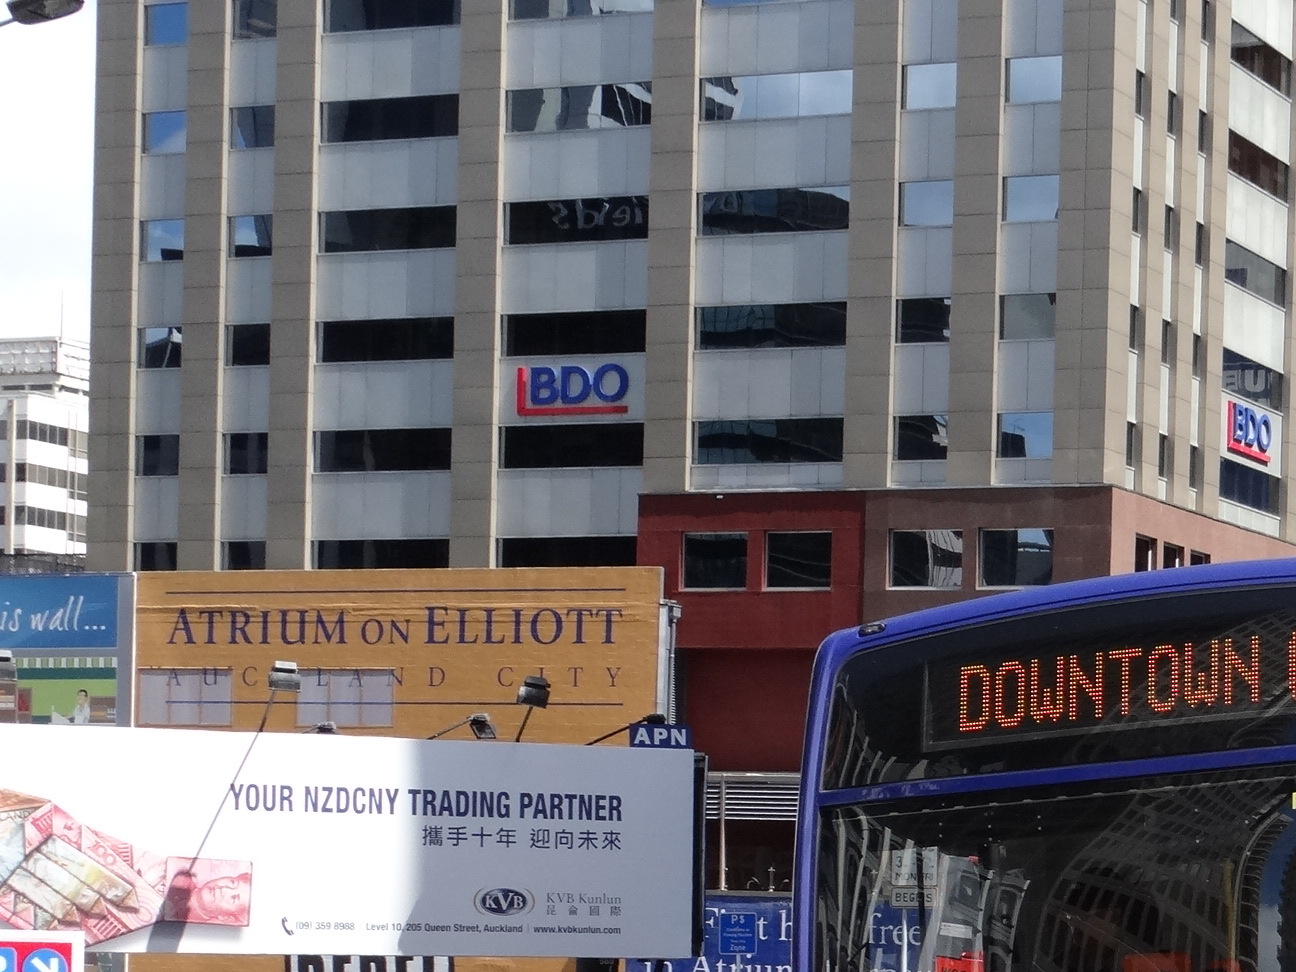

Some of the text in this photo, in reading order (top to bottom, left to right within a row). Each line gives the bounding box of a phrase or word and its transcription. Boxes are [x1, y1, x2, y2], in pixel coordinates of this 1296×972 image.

[530, 363, 629, 406] BDO
[1233, 402, 1272, 453] BDO
[31, 595, 107, 632] wall...
[166, 606, 623, 645] ATRIUM ON ELLIOTT
[166, 666, 446, 688] AUCLAND
[959, 635, 1259, 732] DOWNTOWN
[633, 727, 687, 746] APN
[230, 782, 623, 822] YOUR NZDCNY TRADING PARTNER
[421, 825, 622, 850] 攜手十年 迎向未來
[484, 892, 524, 911] KVB
[546, 892, 622, 904] KVB Kunlun
[895, 892, 933, 903] BEGS
[366, 922, 389, 931] Level
[406, 923, 422, 932] 205
[424, 923, 451, 933] Queen
[454, 924, 482, 933] Street,
[483, 924, 523, 933] Auckland
[533, 925, 622, 935] www.kvbkunlun.com
